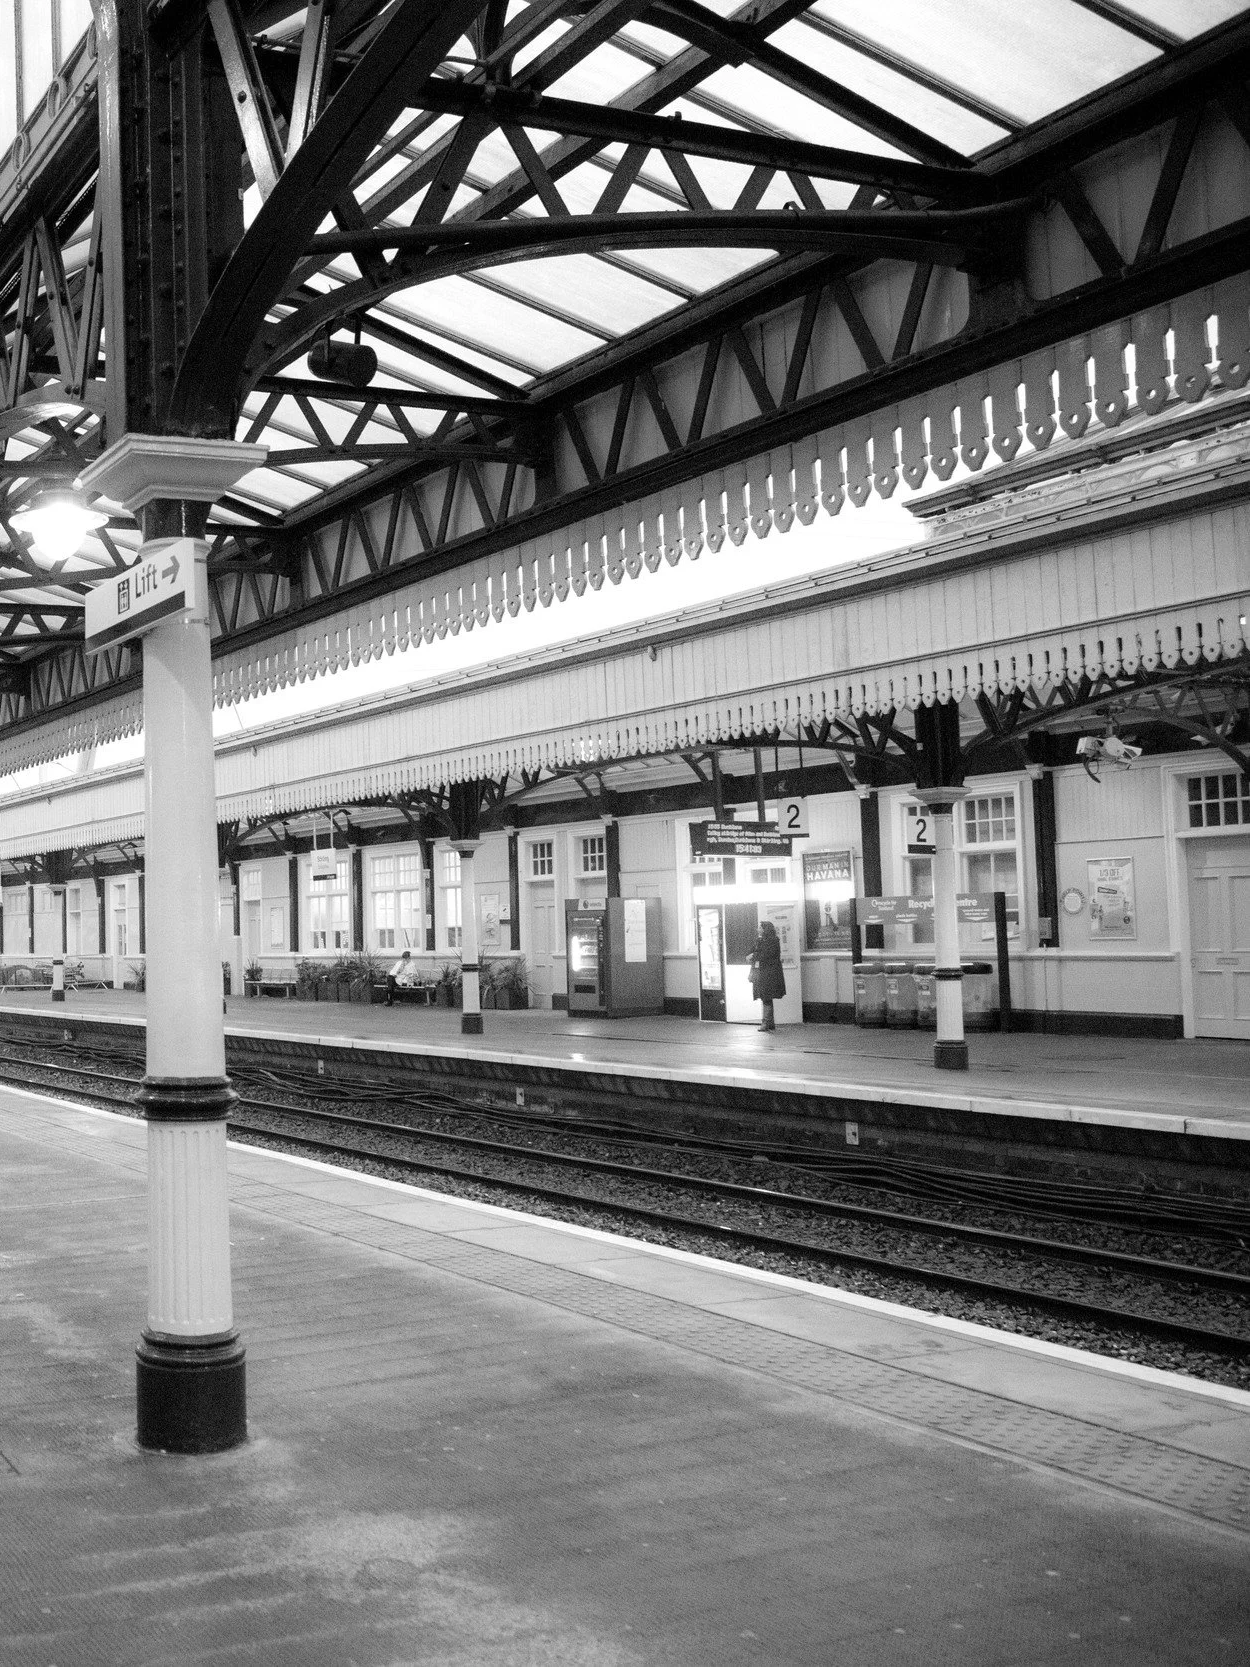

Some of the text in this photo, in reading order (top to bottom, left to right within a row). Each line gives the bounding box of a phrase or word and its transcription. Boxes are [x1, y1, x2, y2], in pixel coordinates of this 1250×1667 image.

[135, 563, 157, 599] Lift
[786, 804, 801, 828] 2
[916, 818, 927, 842] 2
[806, 868, 849, 881] HAVANA
[822, 862, 839, 870] MAN
